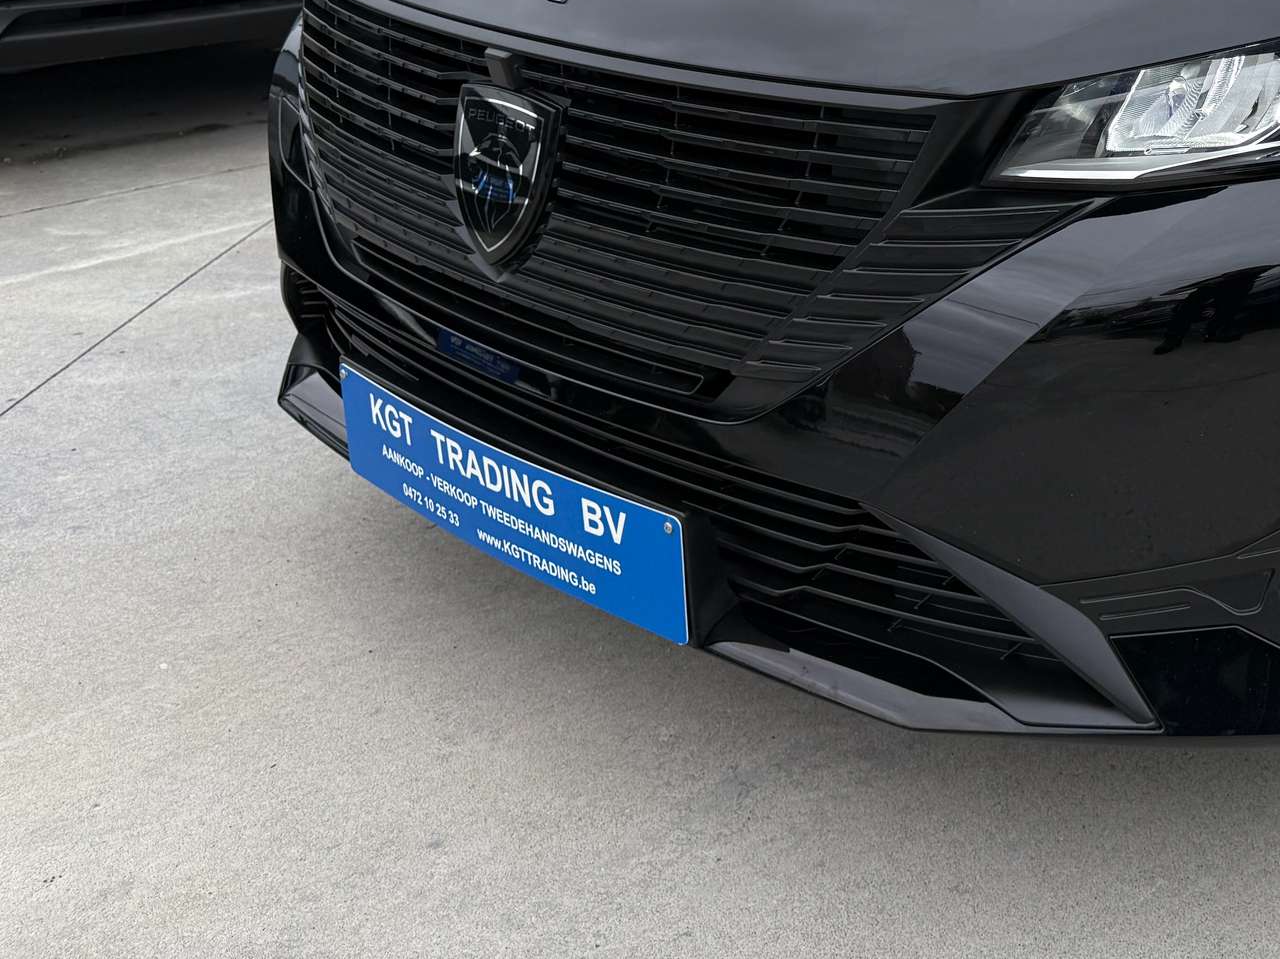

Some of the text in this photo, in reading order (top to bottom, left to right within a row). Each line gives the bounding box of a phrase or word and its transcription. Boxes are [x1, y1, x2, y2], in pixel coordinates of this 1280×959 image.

[469, 108, 536, 136] PEUGEOT
[369, 393, 627, 545] KGT TRADING BV
[381, 444, 425, 480] AANKOOP
[431, 475, 478, 511] VERKOOP
[479, 501, 622, 575] TWEEDEHANDSWAGENS
[402, 483, 597, 595] 0472 10 25 33 www.KGTTRADING.be
